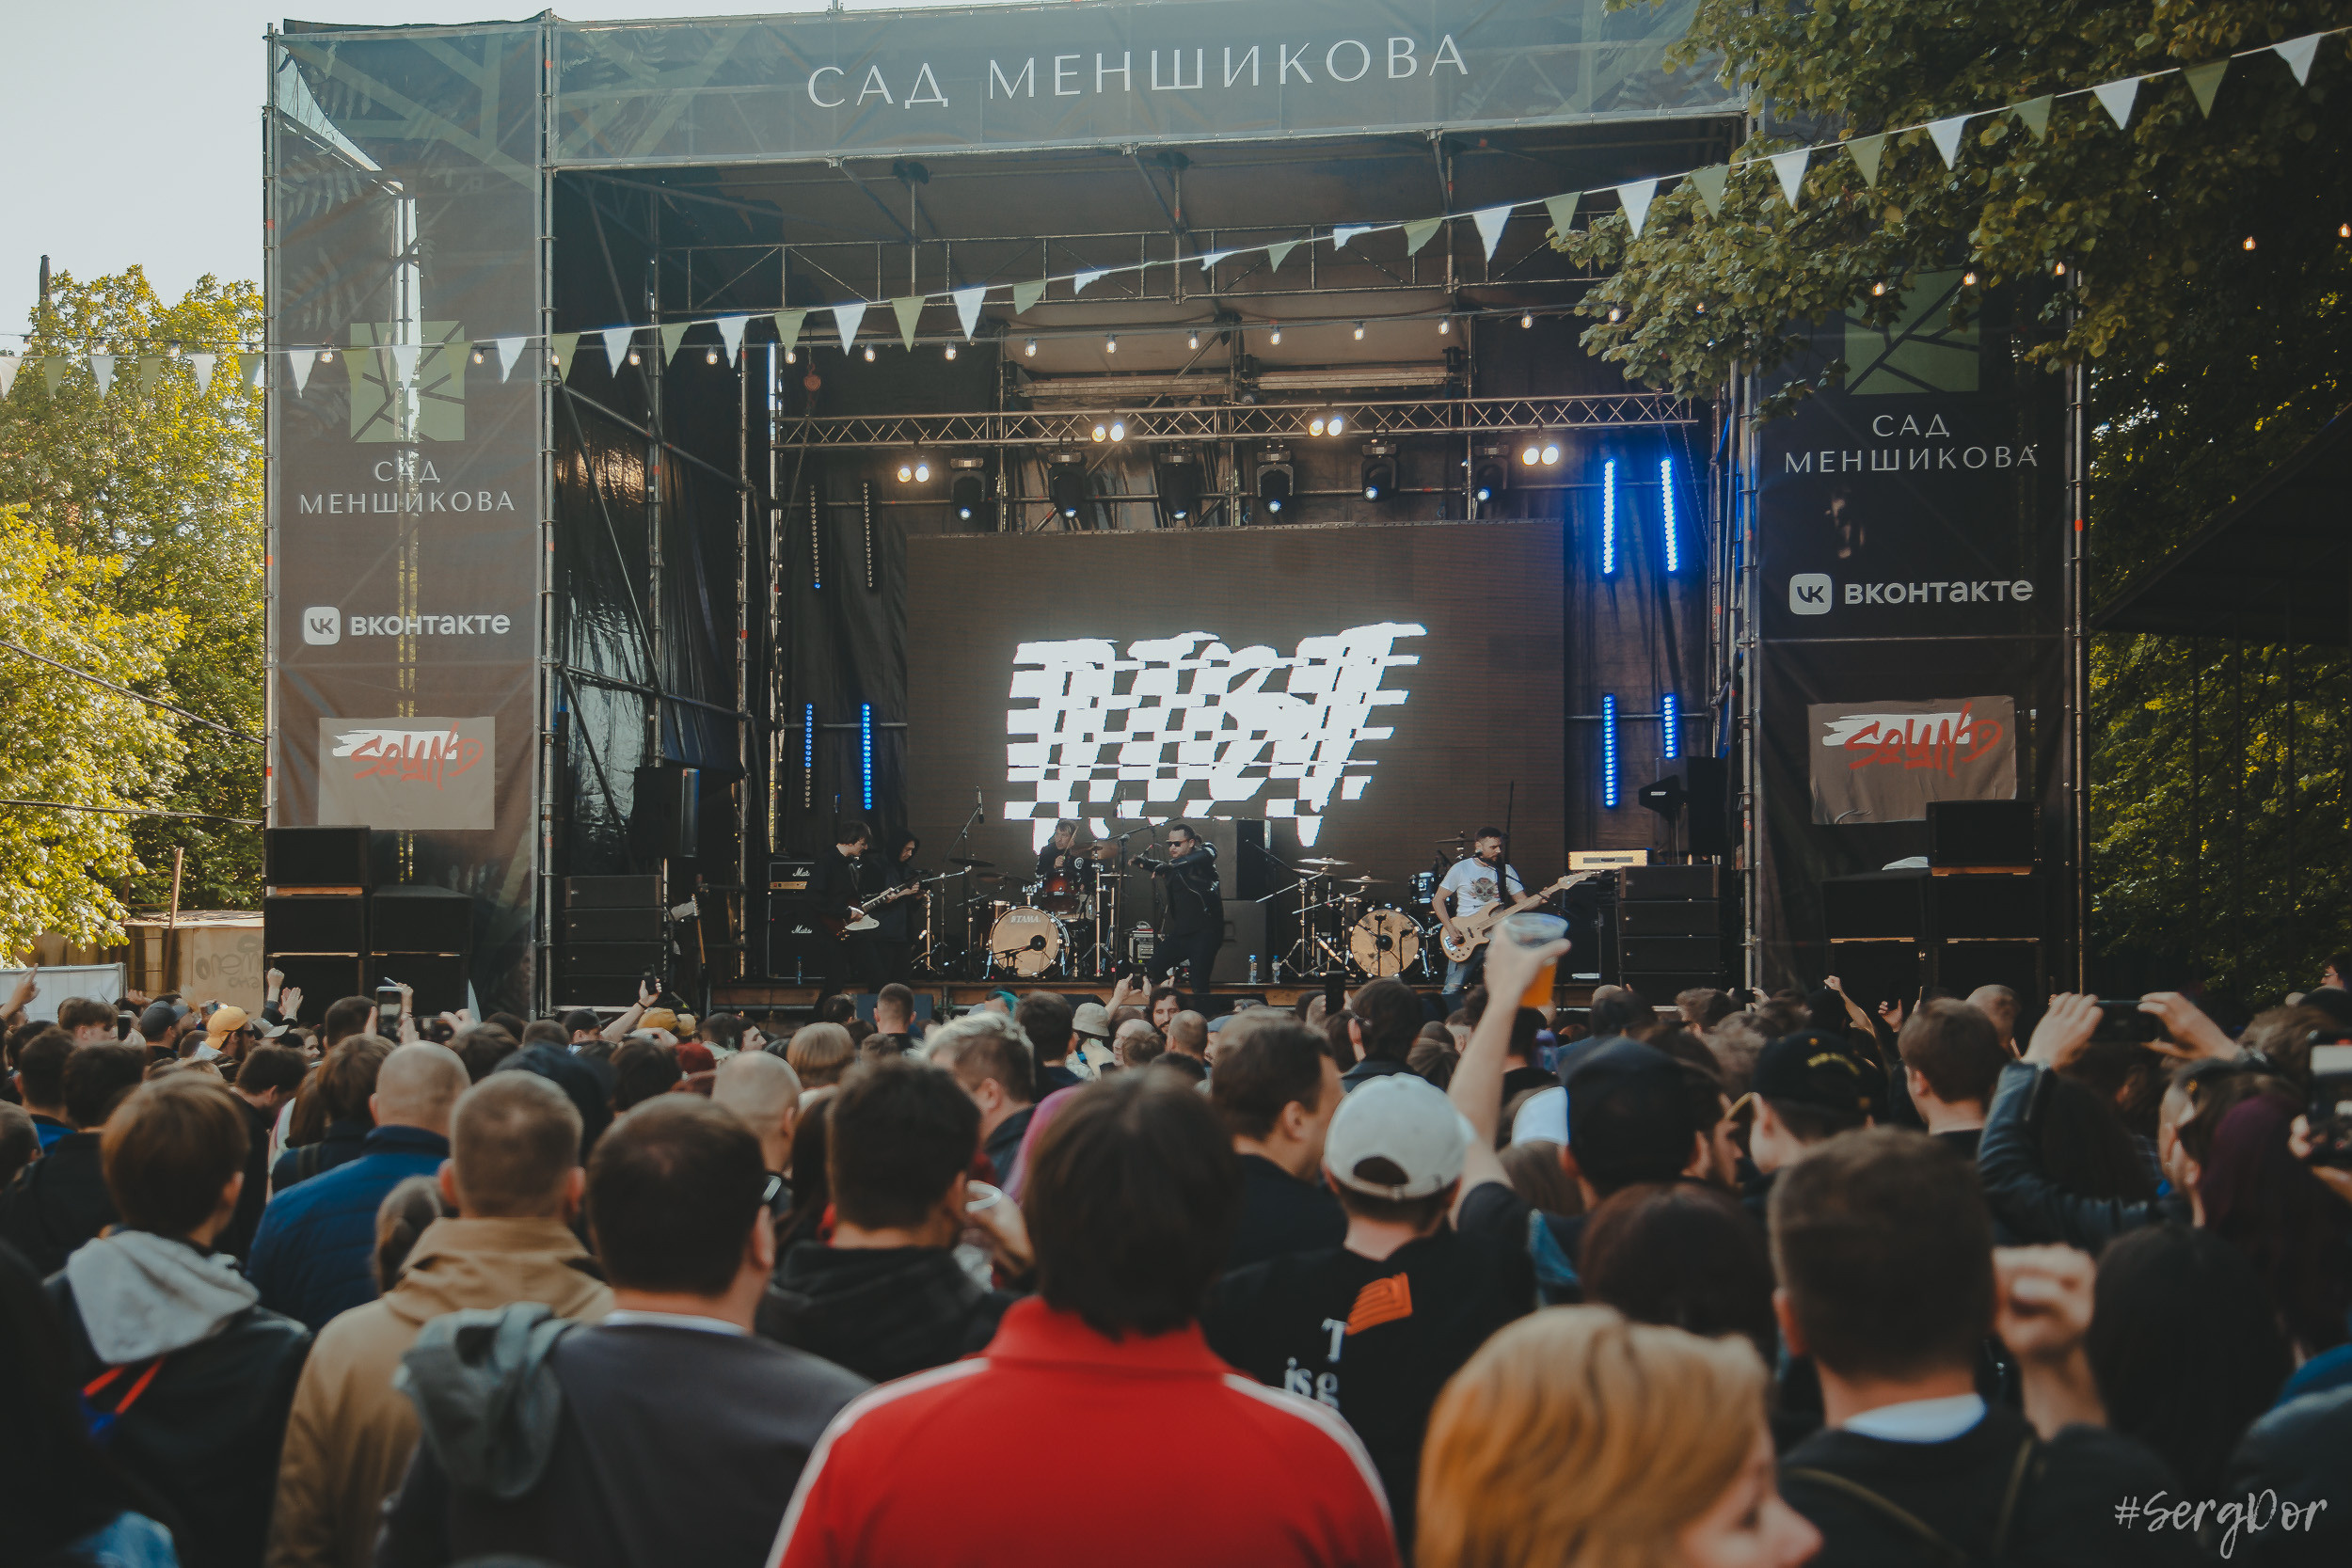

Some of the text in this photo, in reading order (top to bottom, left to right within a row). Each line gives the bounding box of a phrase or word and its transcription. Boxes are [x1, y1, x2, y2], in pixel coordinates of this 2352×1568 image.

[807, 34, 1469, 110] САД МЕНШИКОВА
[1872, 413, 1950, 438] САД
[374, 460, 441, 483] САД
[1786, 445, 2038, 473] МЕНШИКОВА
[300, 490, 516, 515] МЕНШИКОВА
[792, 866, 811, 877] Mar
